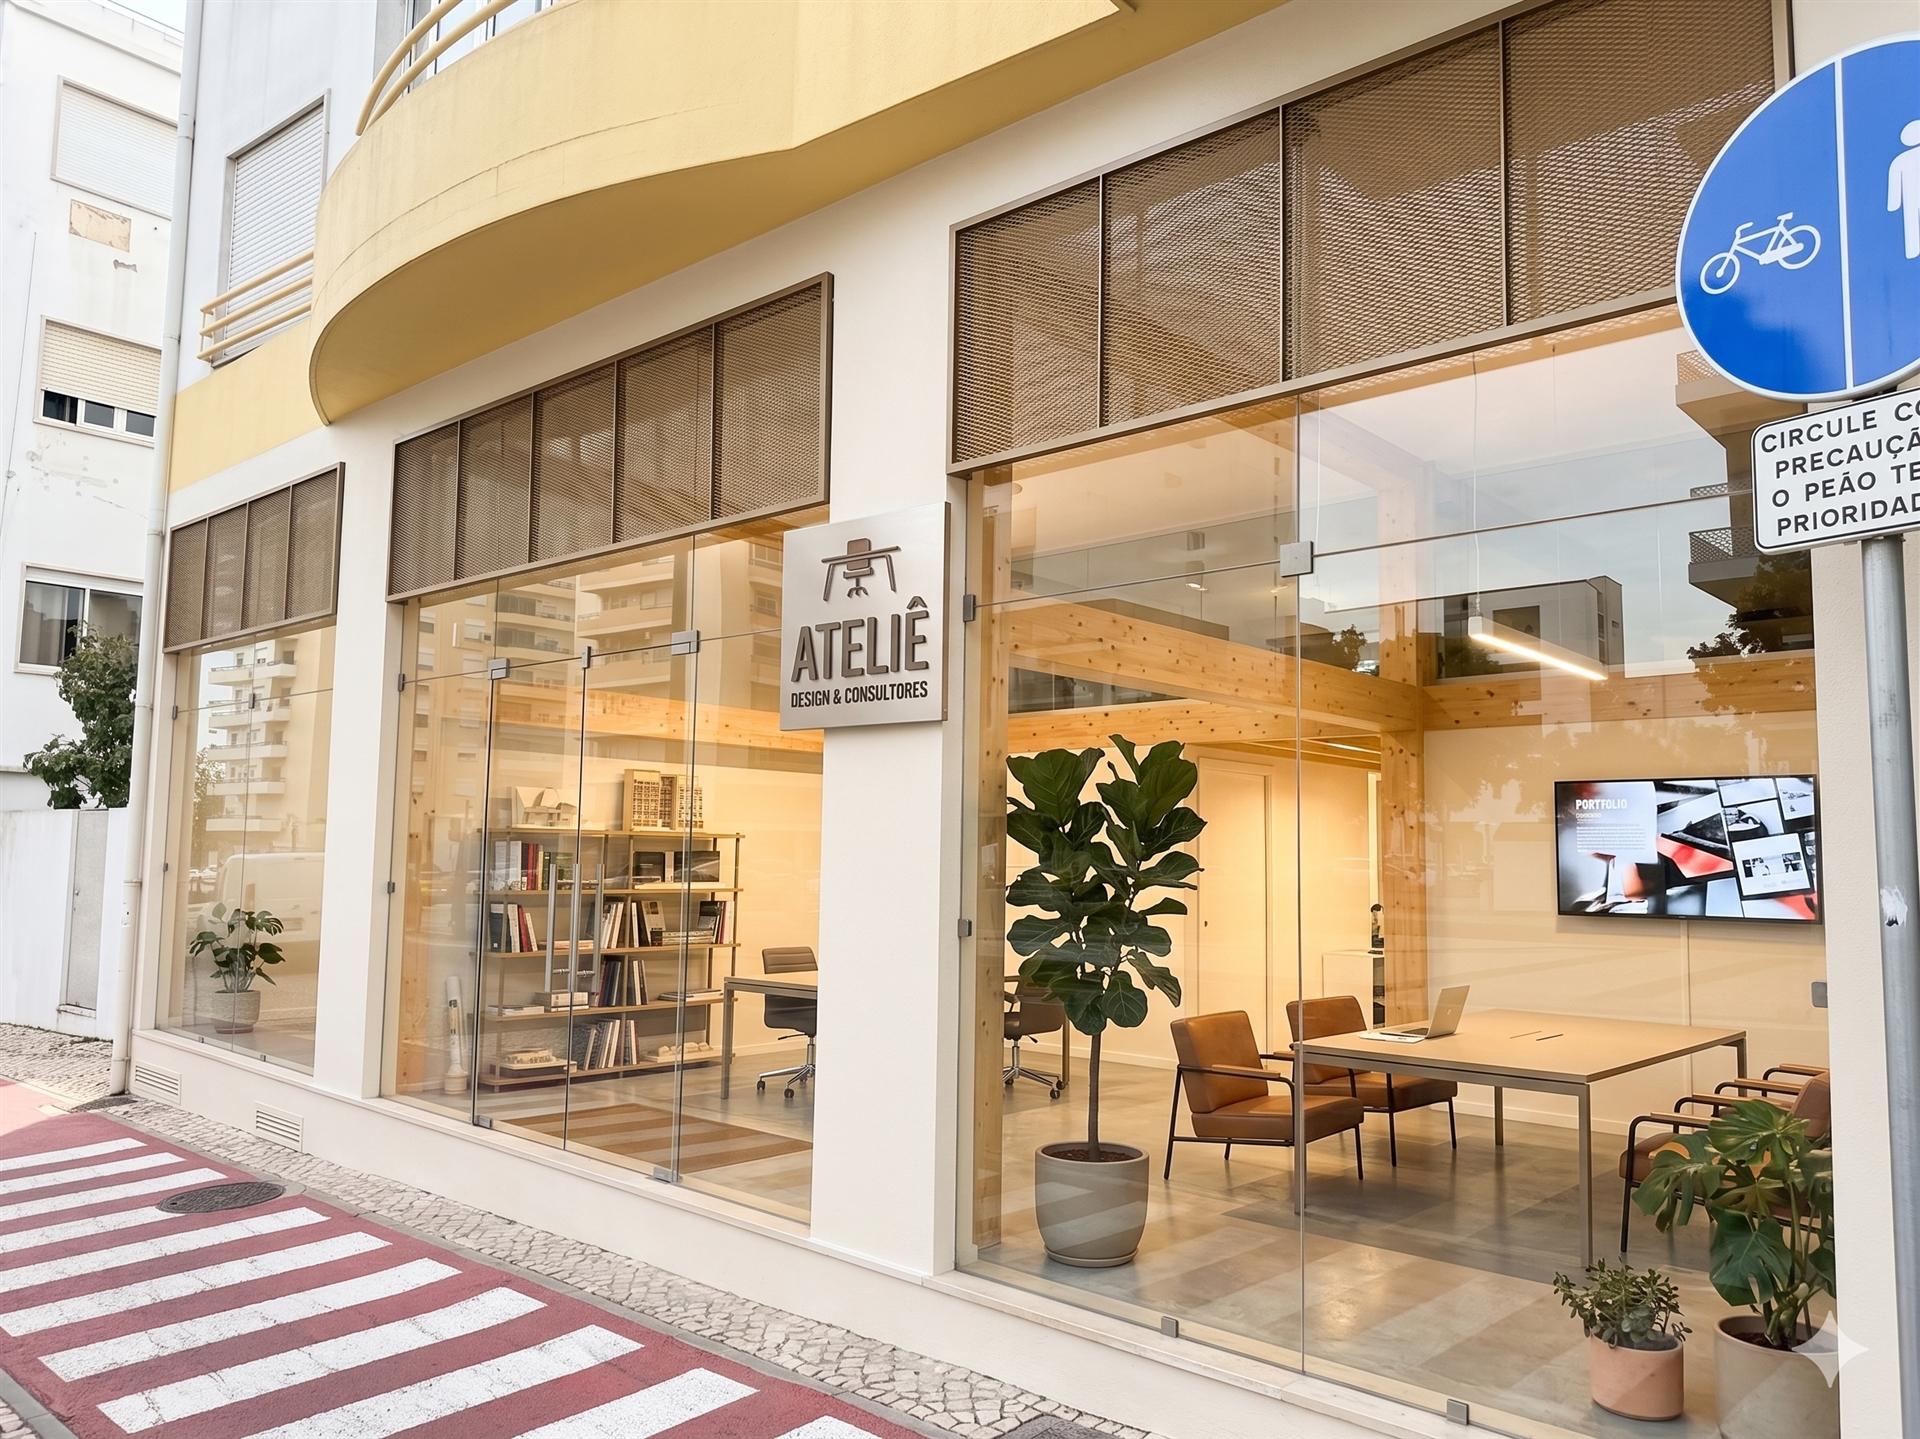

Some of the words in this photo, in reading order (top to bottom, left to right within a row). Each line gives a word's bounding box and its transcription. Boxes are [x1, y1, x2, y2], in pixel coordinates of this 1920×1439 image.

[1761, 410, 1877, 453] CIRCULE
[1776, 427, 1920, 479] PRECAUÇÃ
[1772, 489, 1790, 507] O
[1805, 471, 1876, 502] PEÃO
[791, 595, 929, 682] ATELIÊ
[791, 689, 830, 708] DESIGN
[833, 688, 841, 704] &
[844, 680, 928, 703] CONSULTORES
[1575, 799, 1628, 810] PORTFOLIO
